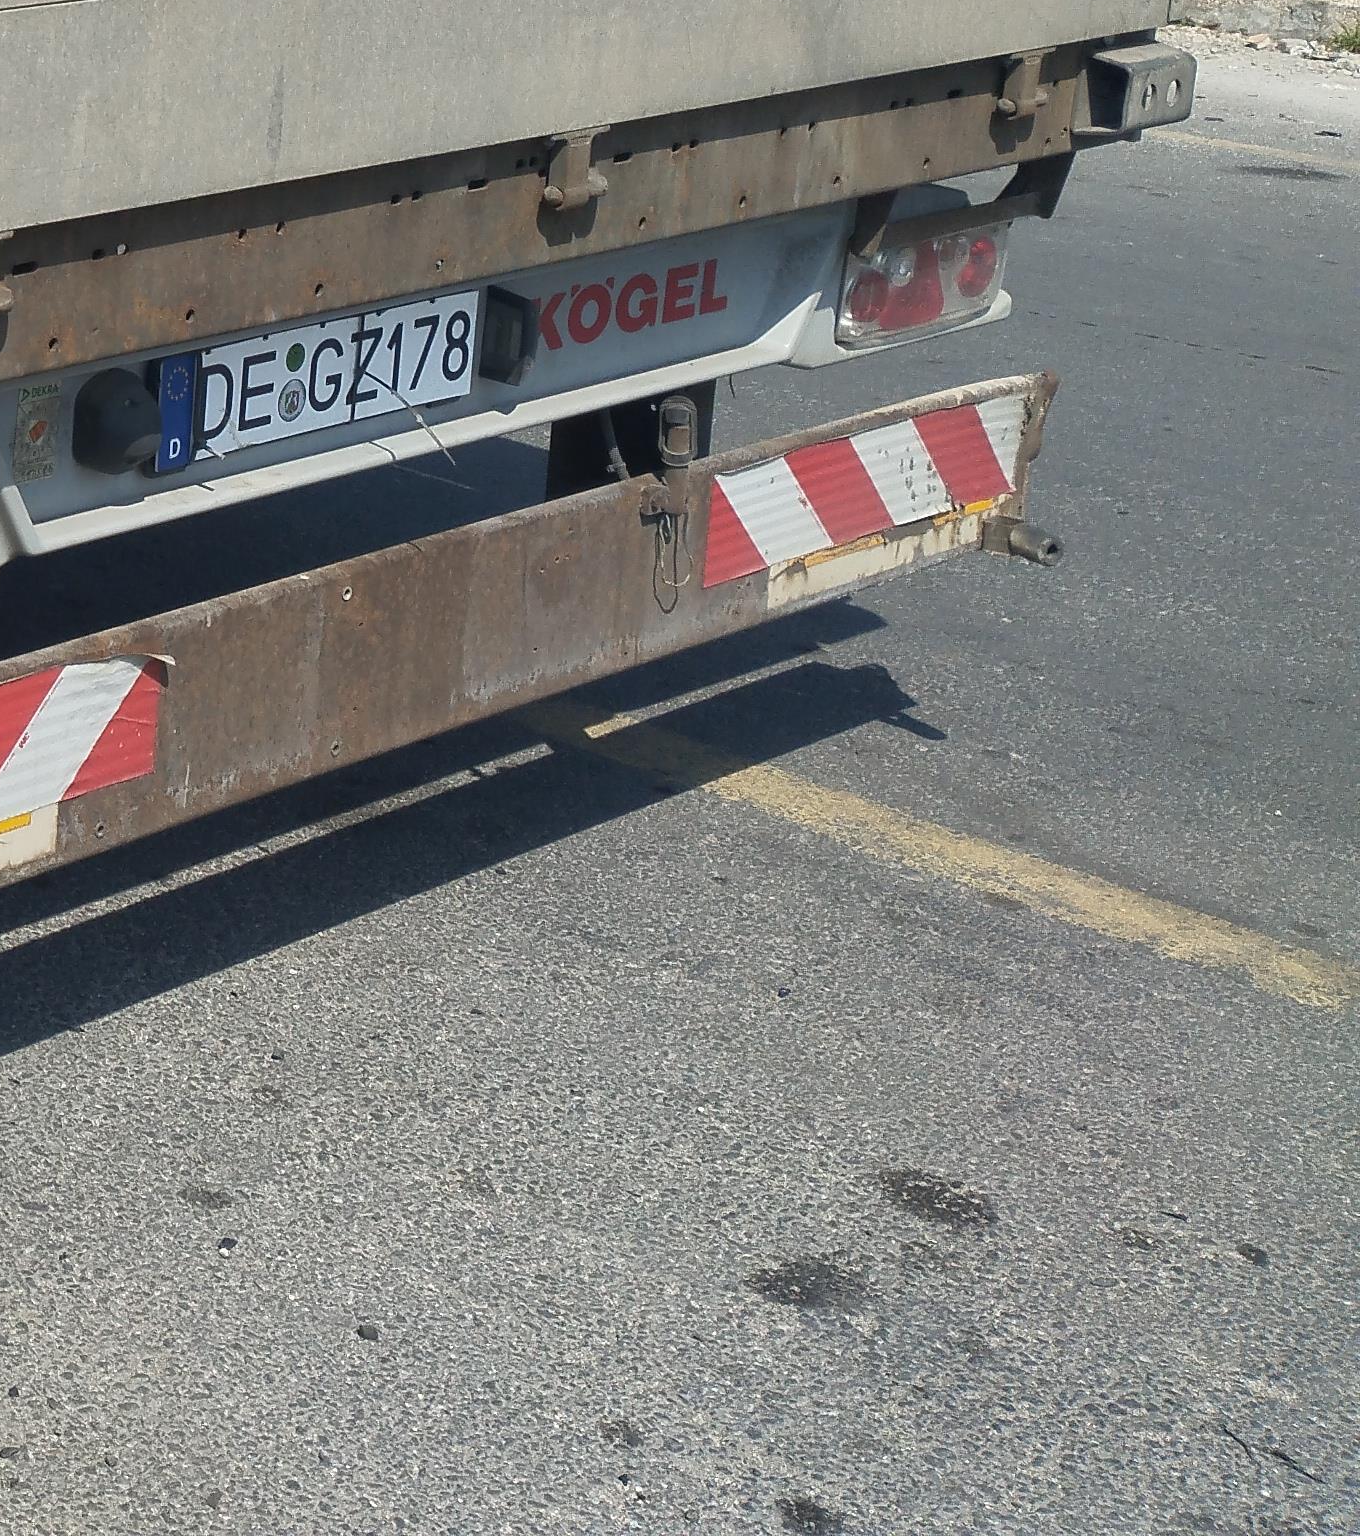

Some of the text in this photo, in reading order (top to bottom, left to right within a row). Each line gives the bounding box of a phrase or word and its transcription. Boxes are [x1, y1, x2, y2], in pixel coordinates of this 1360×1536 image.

[530, 258, 728, 351] KÖGEL
[169, 437, 181, 459] D
[197, 350, 277, 441] DE
